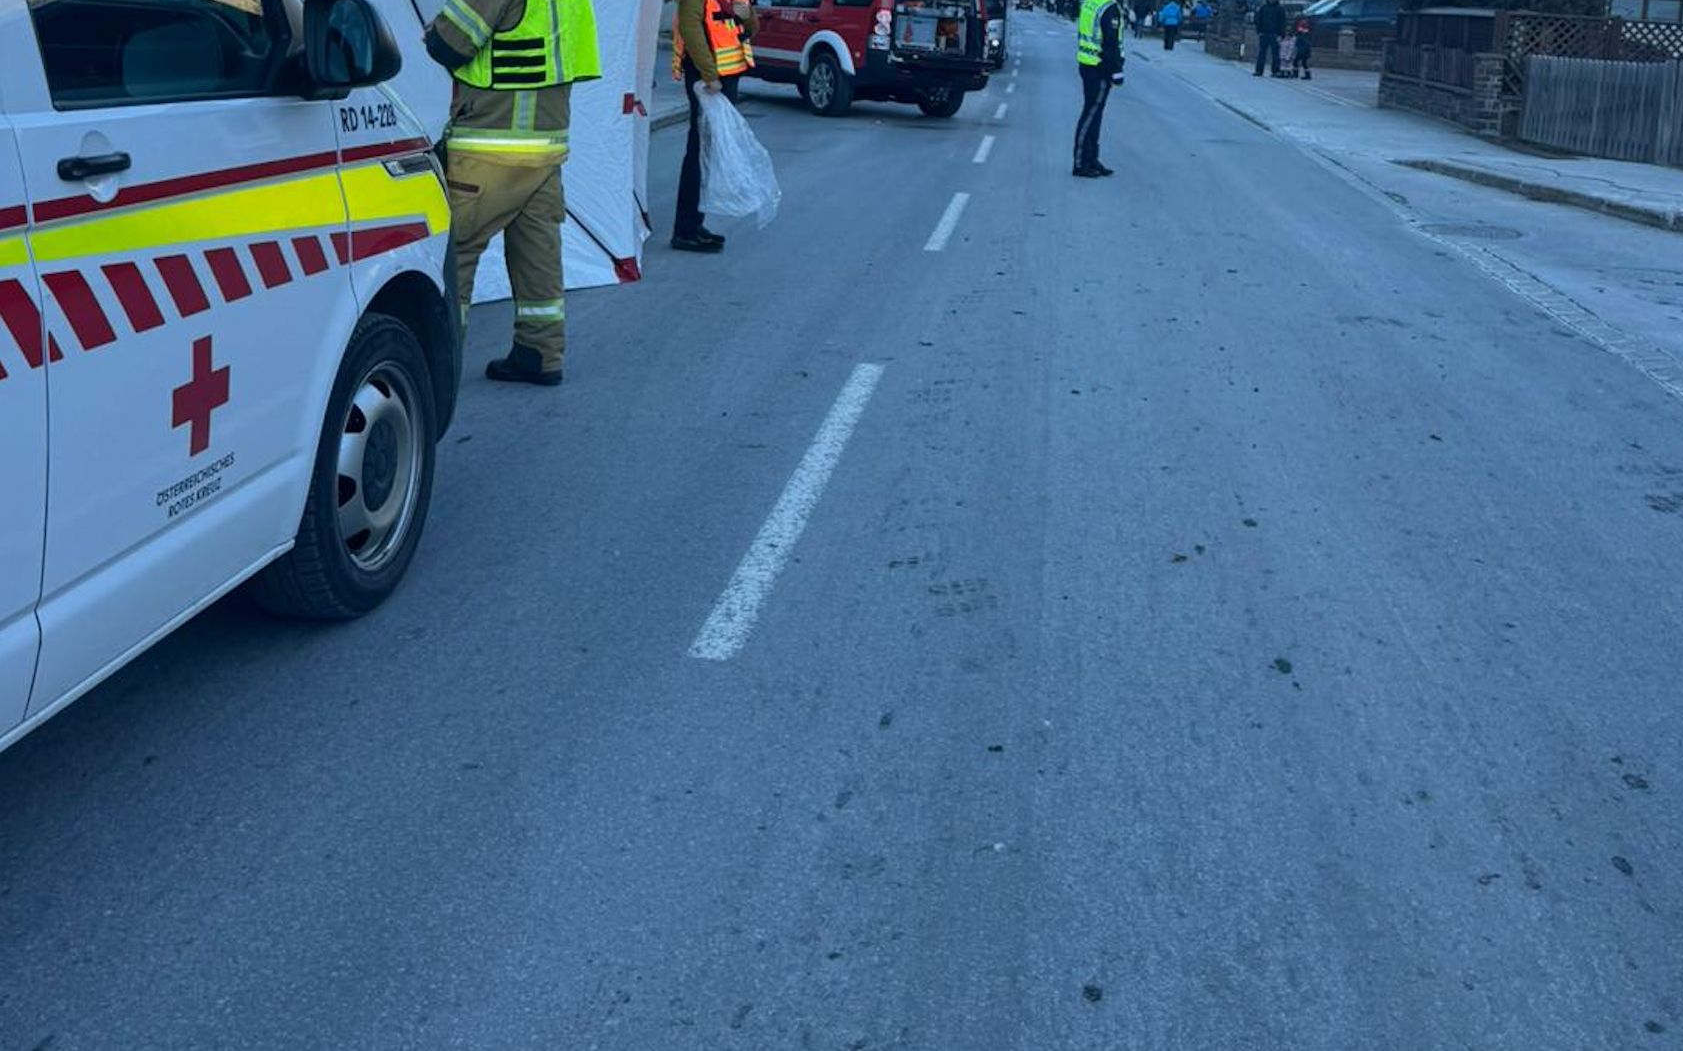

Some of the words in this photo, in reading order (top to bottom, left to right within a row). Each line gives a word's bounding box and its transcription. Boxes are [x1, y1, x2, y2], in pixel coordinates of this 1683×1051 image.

[340, 107, 358, 132] RD
[156, 451, 235, 506] ÖSTERREICHISCHES
[168, 492, 195, 518] ROTES
[196, 477, 222, 500] KREUZ
